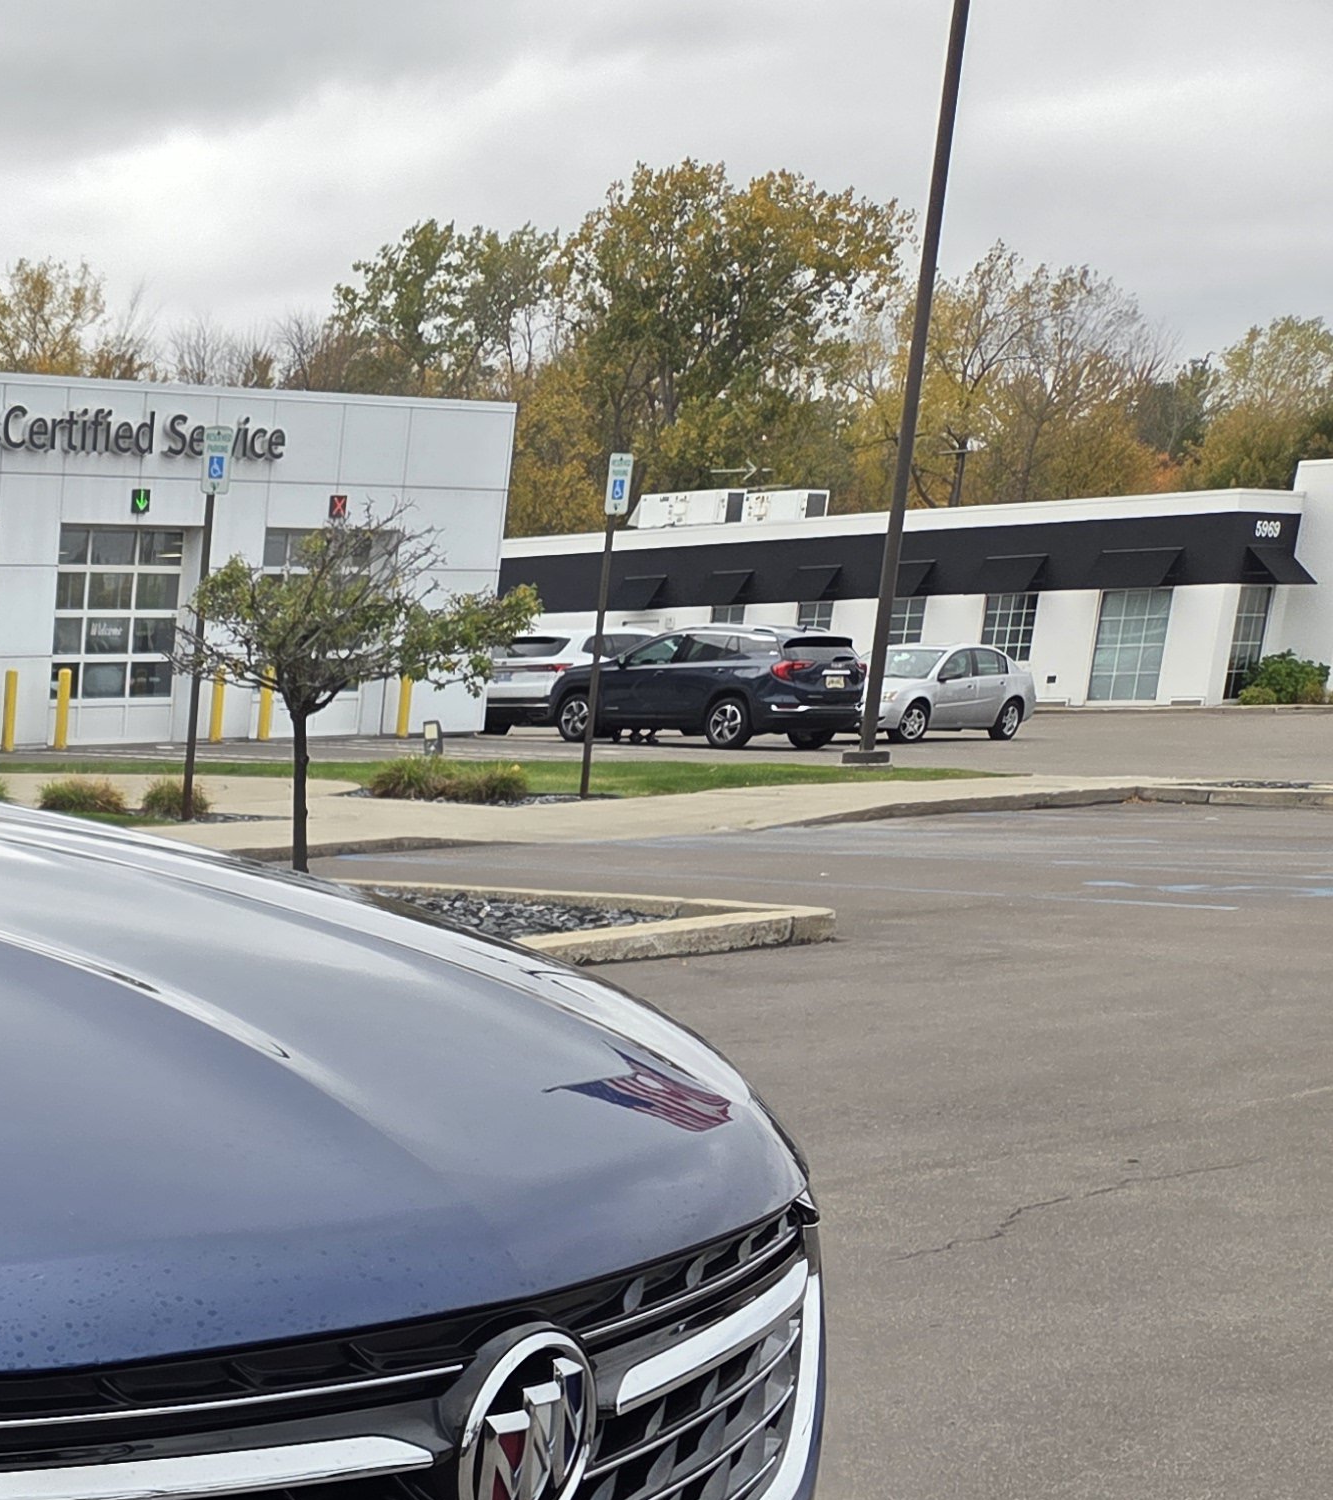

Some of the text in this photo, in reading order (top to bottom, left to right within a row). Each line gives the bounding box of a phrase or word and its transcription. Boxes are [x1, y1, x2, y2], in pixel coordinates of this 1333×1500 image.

[0, 404, 287, 460] Certified Seice
[1255, 520, 1281, 538] 5969
